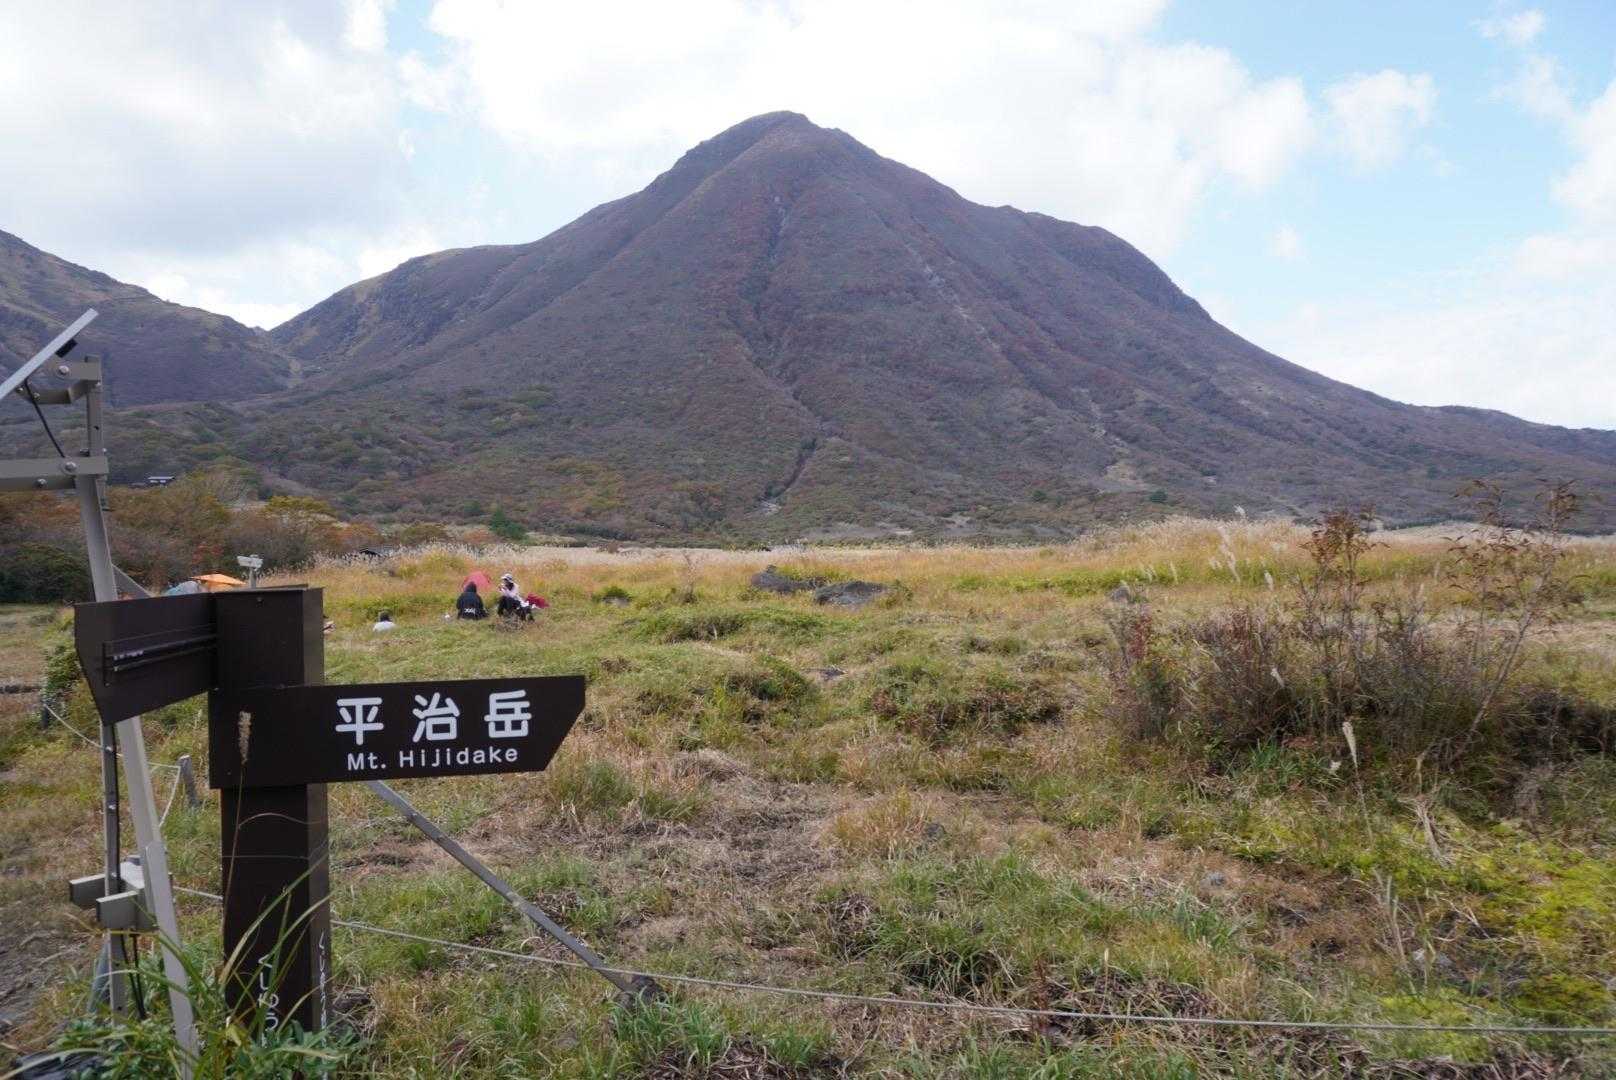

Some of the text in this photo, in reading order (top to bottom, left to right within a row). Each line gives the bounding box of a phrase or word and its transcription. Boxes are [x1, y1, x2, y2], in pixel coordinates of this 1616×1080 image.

[335, 690, 533, 746] 平治岳
[347, 745, 519, 772] Mt. Hijidake
